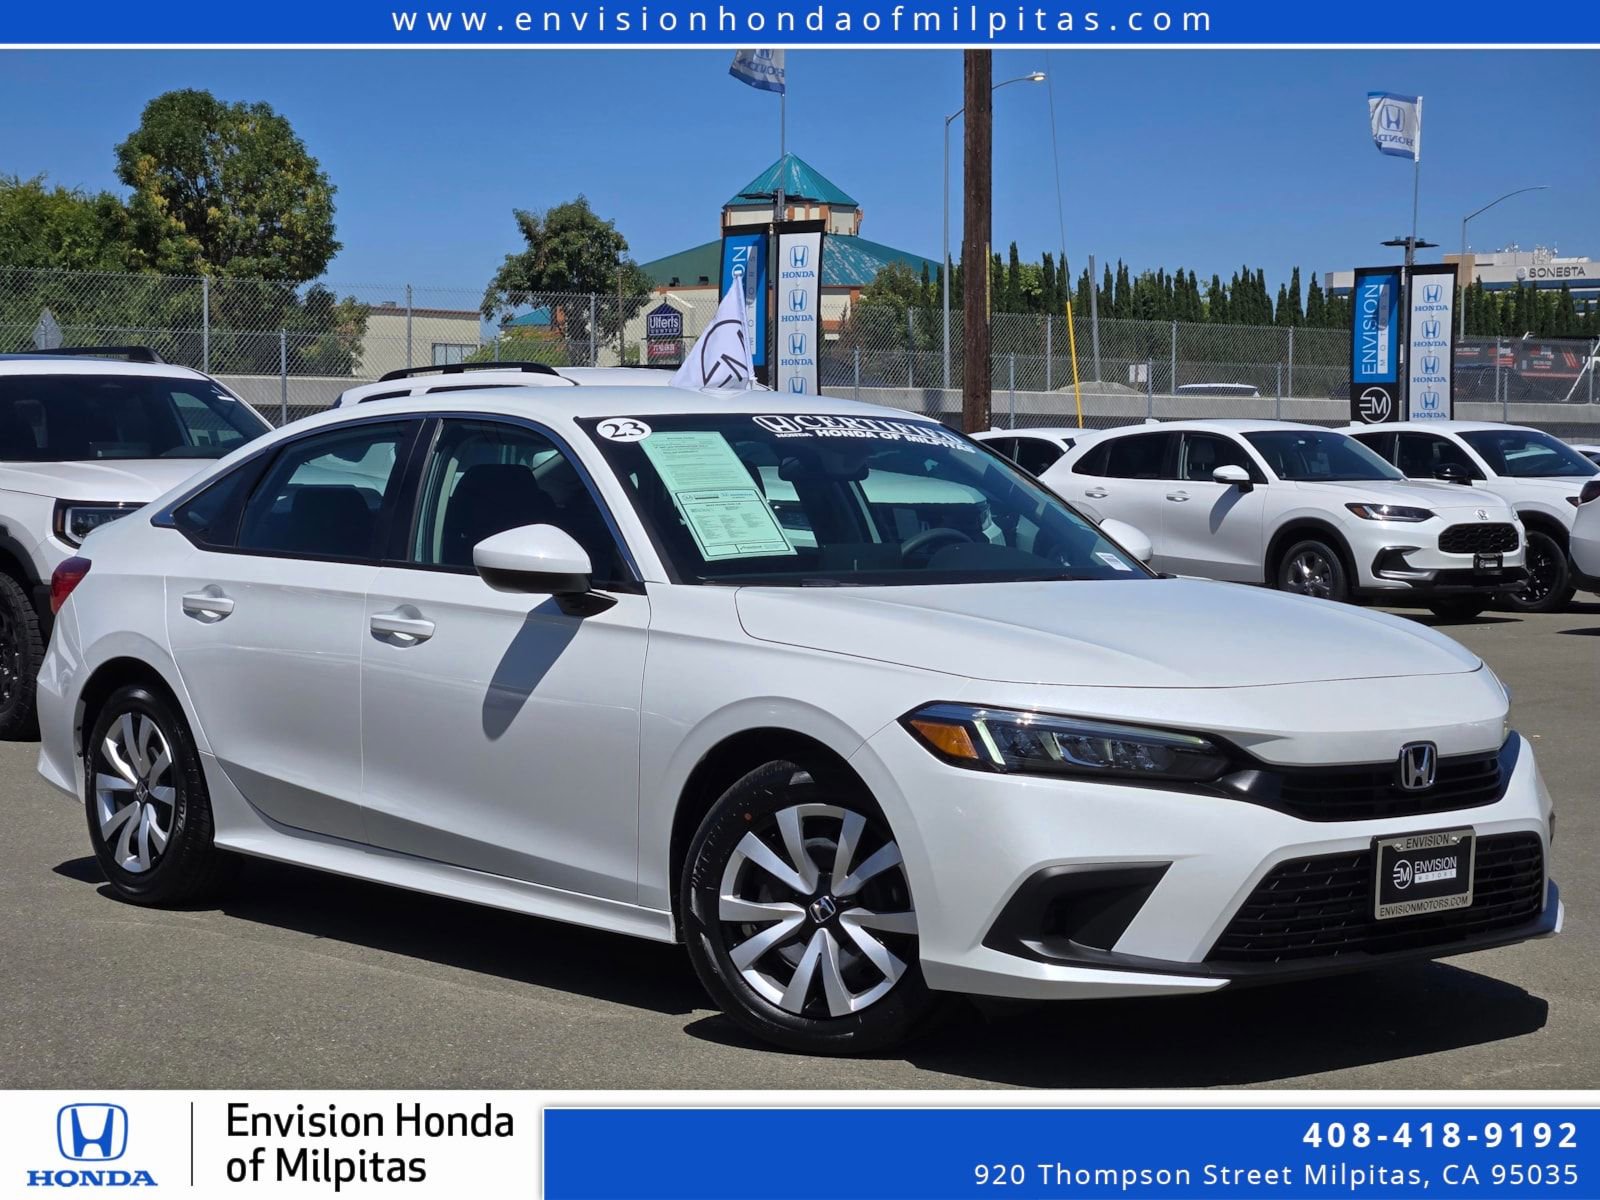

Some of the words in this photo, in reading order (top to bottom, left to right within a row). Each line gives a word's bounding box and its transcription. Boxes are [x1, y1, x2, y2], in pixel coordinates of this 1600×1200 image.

[781, 271, 815, 279] HONDA
[1529, 267, 1586, 278] SONESTA
[781, 314, 814, 322] HONDA
[1361, 284, 1379, 375] ENVISION
[1413, 340, 1448, 348] HONDA
[780, 358, 814, 366] HONDA
[602, 421, 646, 439] 23
[816, 429, 876, 439] HONDA
[879, 432, 902, 441] OF
[1406, 834, 1450, 849] ENVISION
[1414, 856, 1457, 874] ENVISION
[1380, 896, 1468, 917] ENVISIONMOTORS.COM
